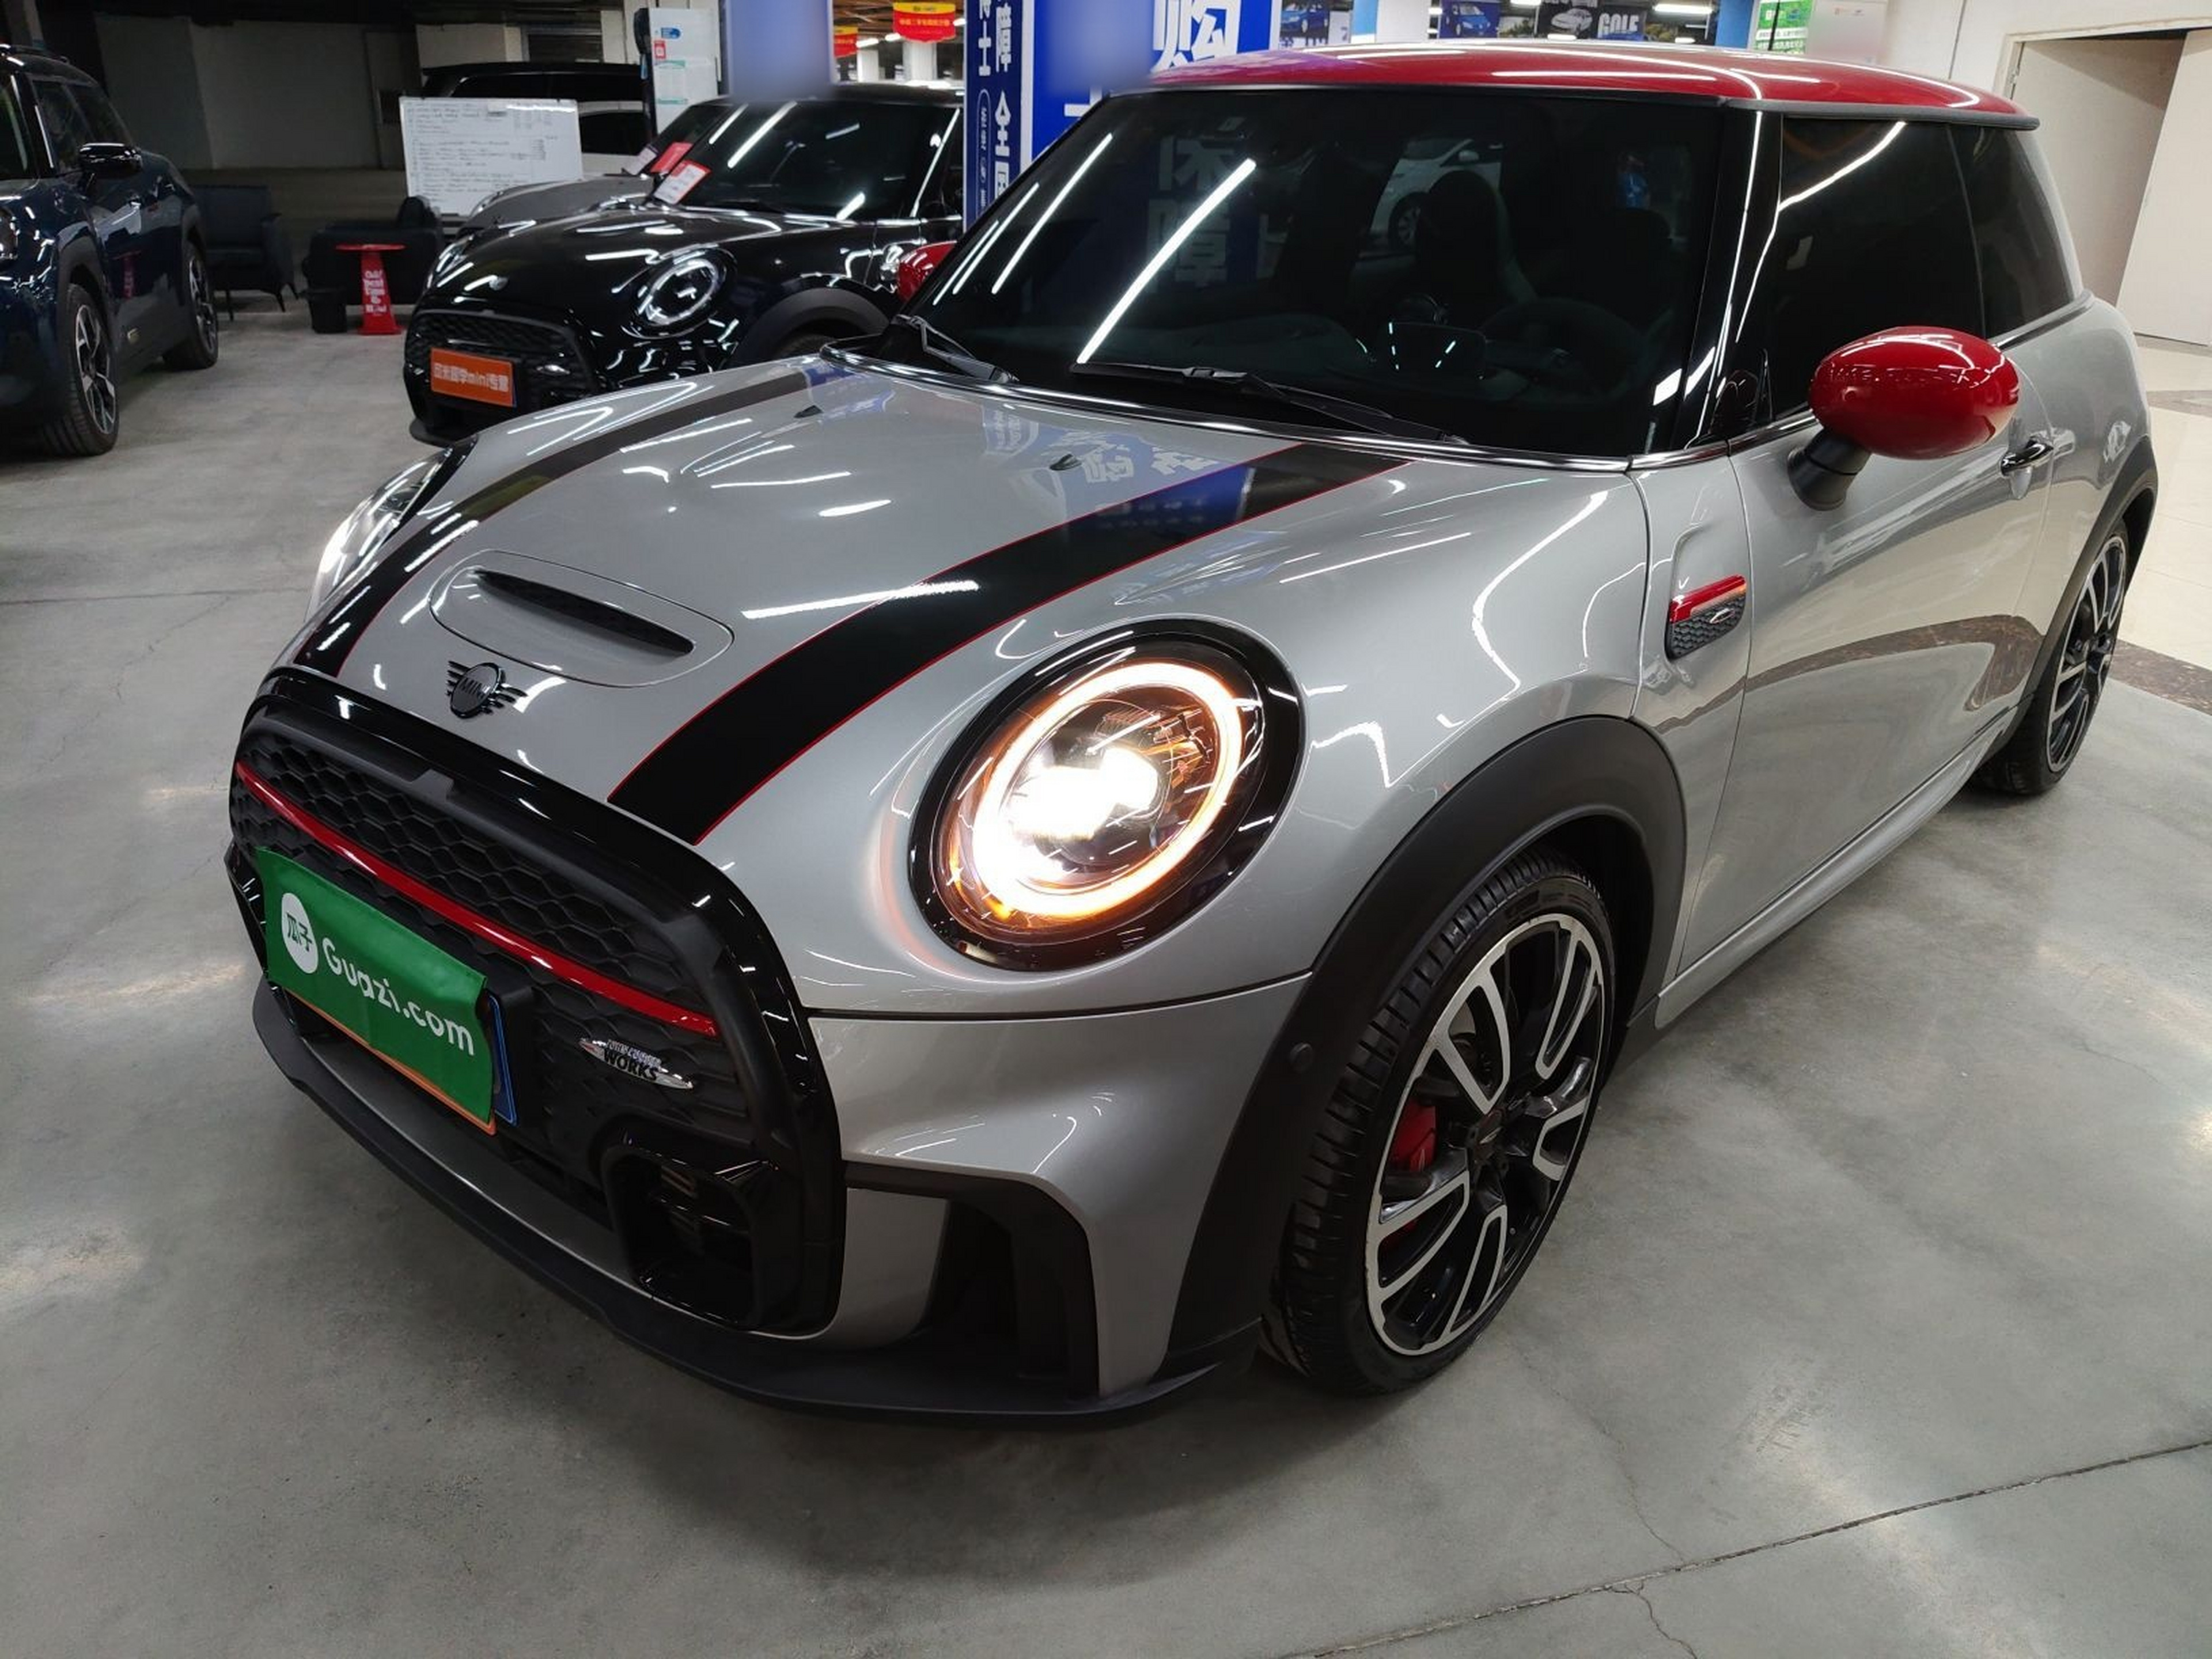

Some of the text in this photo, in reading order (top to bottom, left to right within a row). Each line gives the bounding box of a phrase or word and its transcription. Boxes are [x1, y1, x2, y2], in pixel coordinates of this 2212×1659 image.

[1150, 0, 1241, 71] 购
[286, 912, 313, 952] 瓜子
[321, 936, 475, 1056] Guazi.com
[604, 1050, 659, 1081] WORKS
